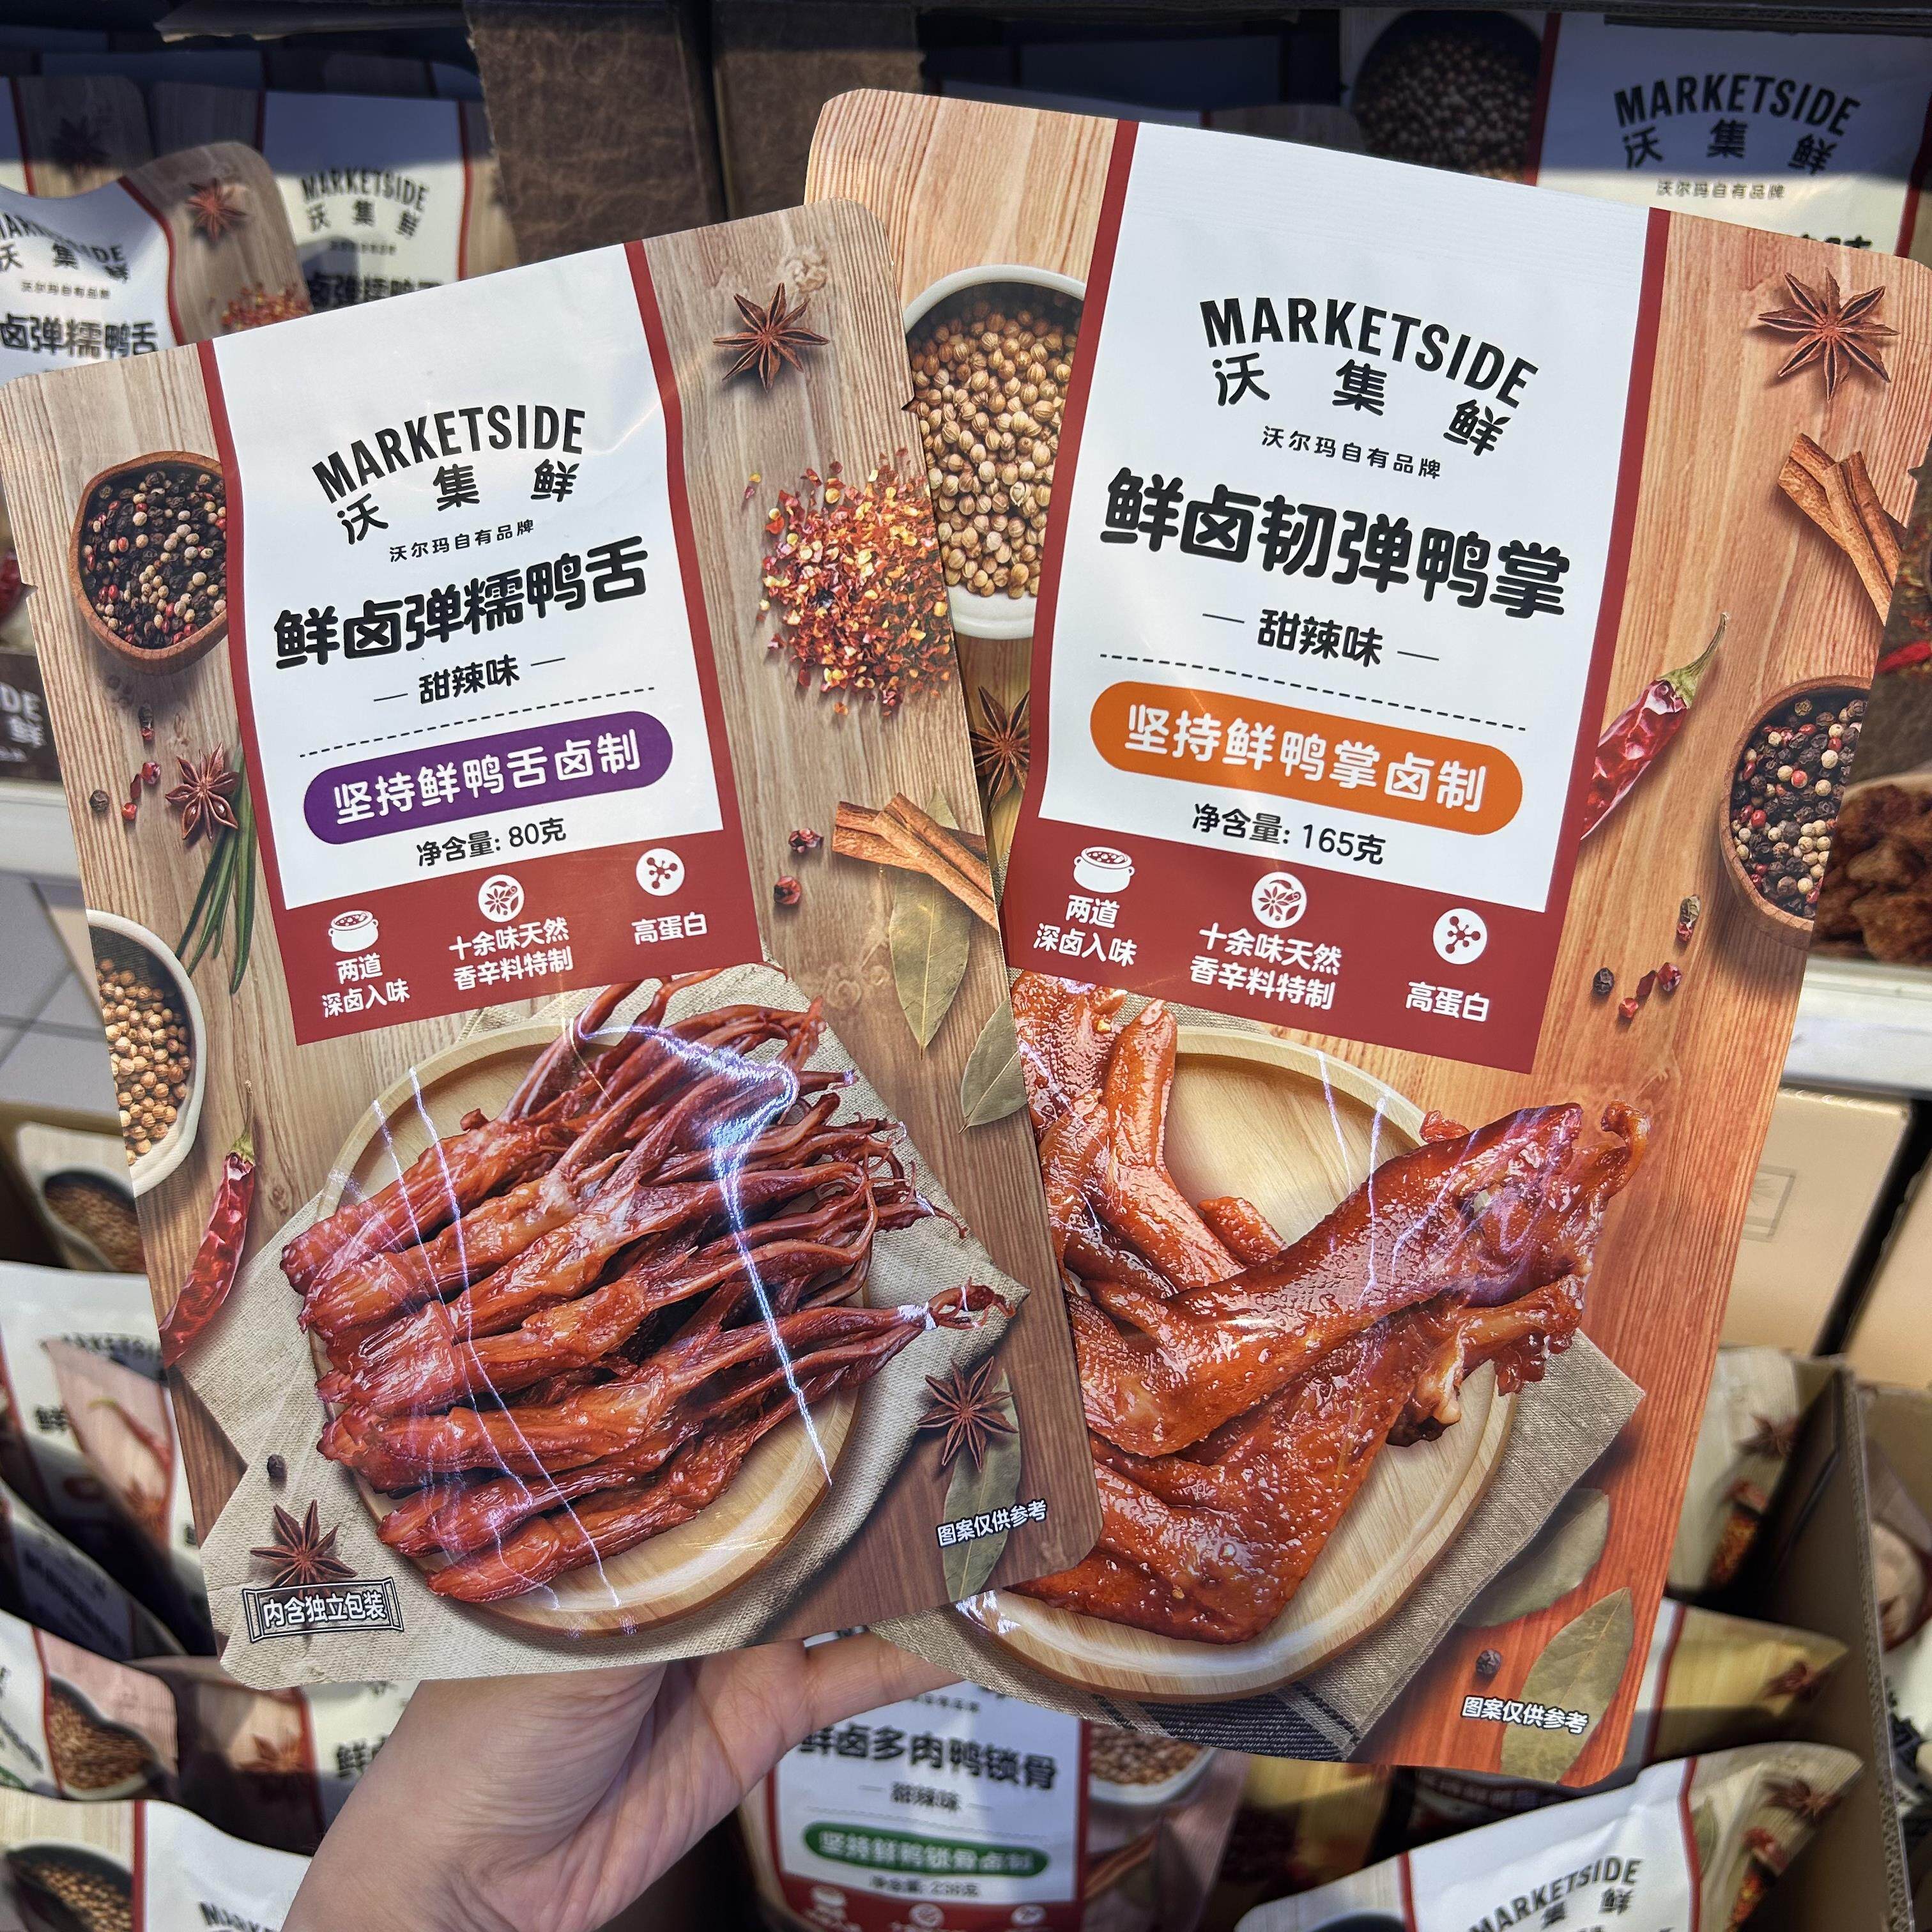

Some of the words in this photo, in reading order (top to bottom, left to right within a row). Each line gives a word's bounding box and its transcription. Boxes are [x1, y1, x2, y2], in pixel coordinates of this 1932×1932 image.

[1614, 73, 1861, 136] MARKETSIDE
[1199, 296, 1540, 410] MARKETSIDE
[311, 404, 585, 504] MARKETSIDE
[1261, 425, 1442, 480] 沃尔玛自有品牌
[388, 518, 535, 563] 沃尔玛自有品牌
[1100, 466, 1570, 620] 鲜卤韧弹鸭掌
[273, 535, 649, 669] 鲜卤弹糯鸭舌
[1257, 608, 1384, 668] 甜辣味
[418, 654, 520, 704] 甜辣味
[333, 728, 640, 825] 坚持鲜鸭舌卤制
[1124, 703, 1487, 813] 坚持鲜鸭掌卤制
[631, 912, 709, 946] 高蛋白
[1064, 894, 1120, 930] 两道
[448, 916, 571, 961] 十余味天然
[1032, 923, 1138, 967] 深卤入味
[1198, 923, 1343, 976] 十余味天然
[335, 953, 384, 985] 两道
[453, 945, 574, 992] 香辛料特制
[1189, 956, 1337, 1011] 香辛料特制
[321, 978, 411, 1018] 深卤入味
[1404, 981, 1490, 1023] 高蛋白
[937, 1499, 1047, 1548] 图案仅供参考
[263, 1591, 388, 1628] 内含独立包装
[1461, 1695, 1590, 1736] 图案仅供参考
